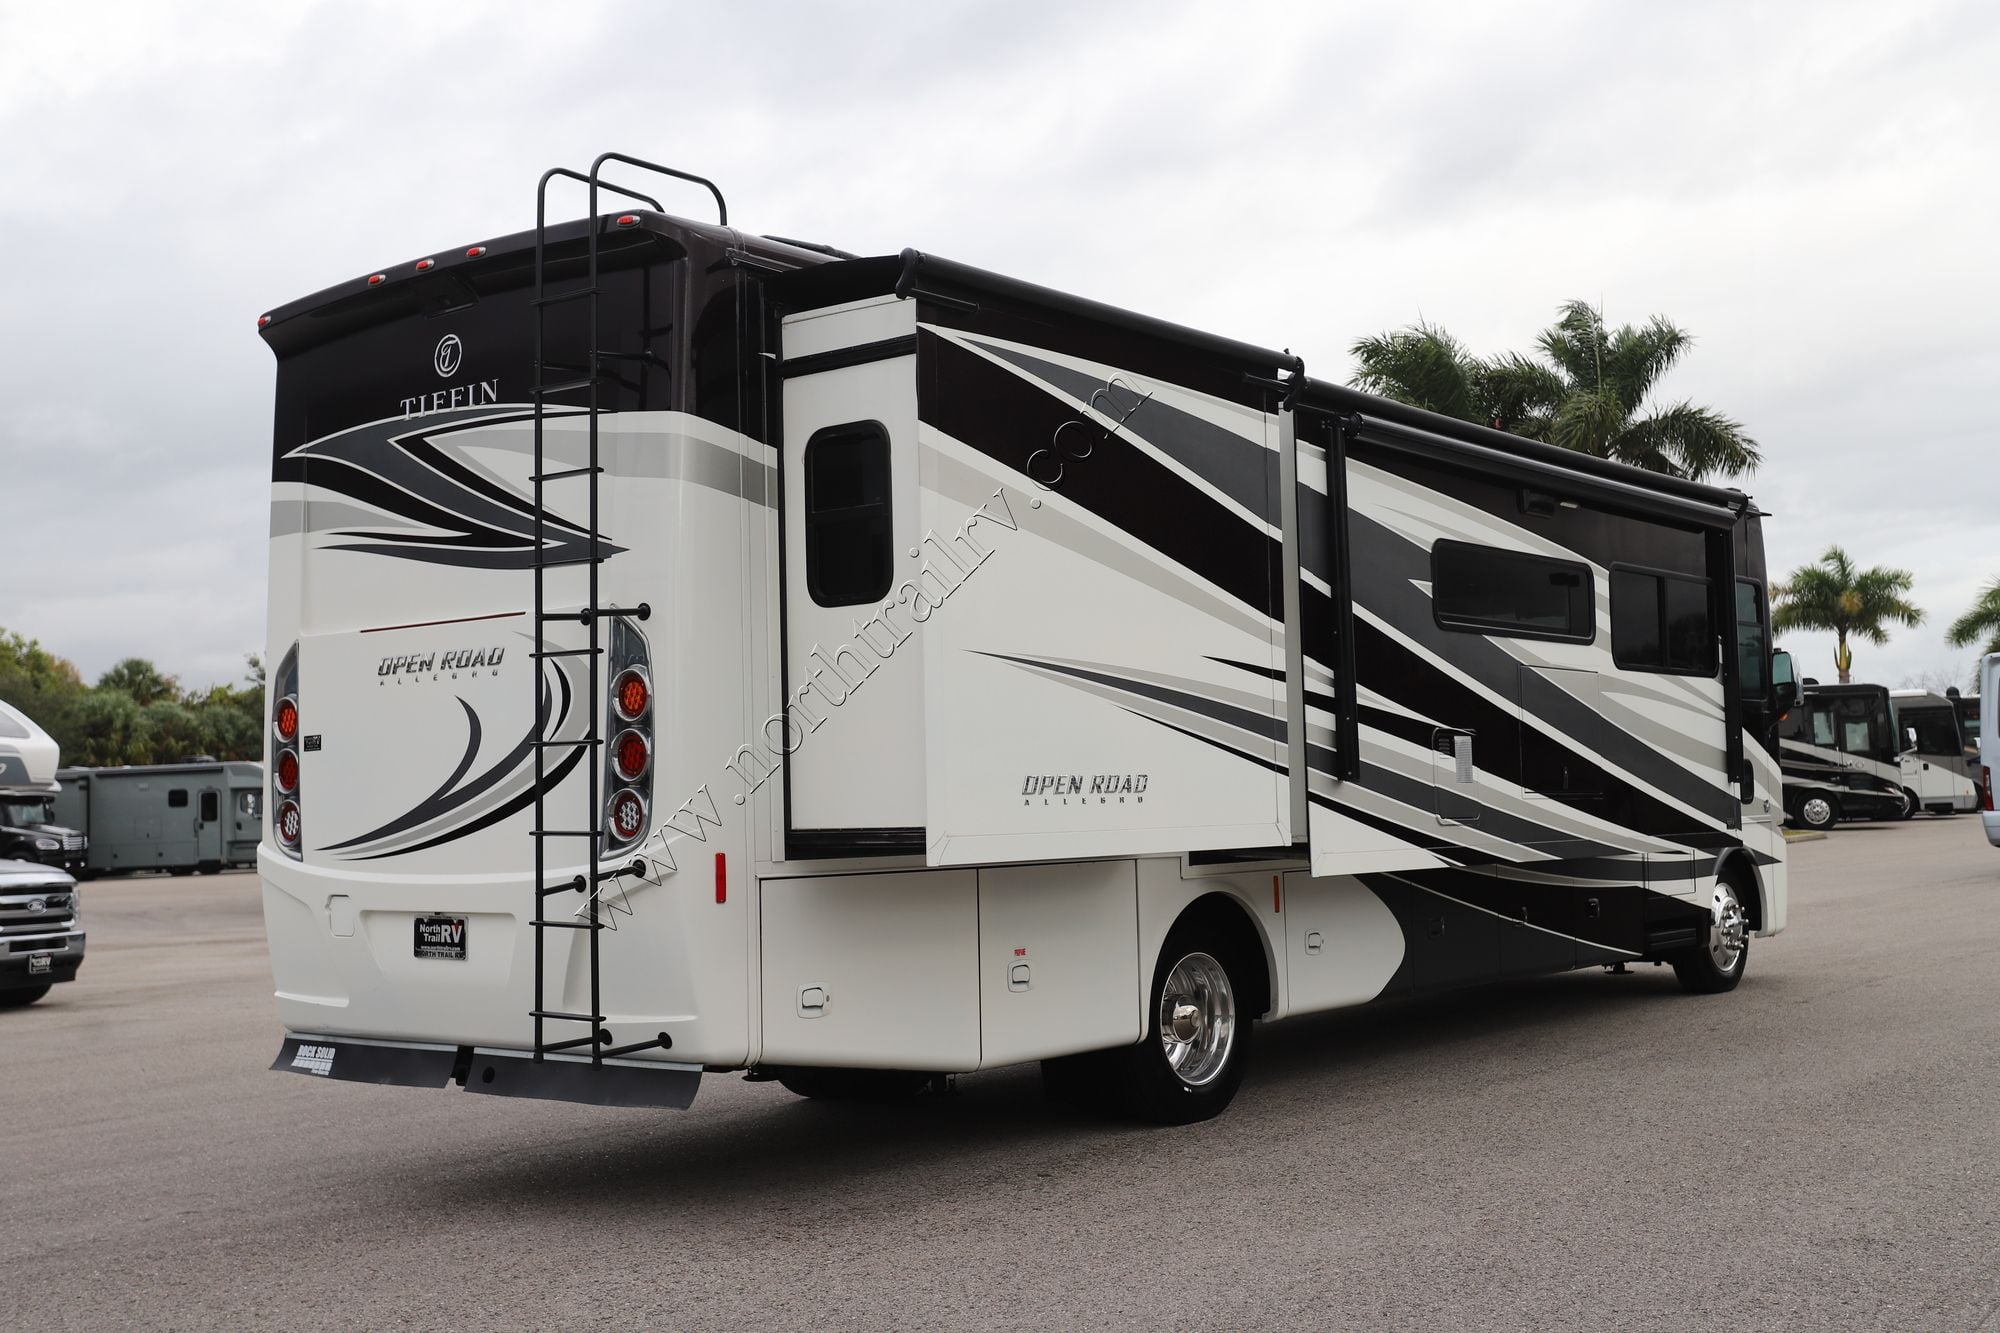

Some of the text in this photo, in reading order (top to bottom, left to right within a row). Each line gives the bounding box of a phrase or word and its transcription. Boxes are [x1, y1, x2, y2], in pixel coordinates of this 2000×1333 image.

[400, 378, 499, 421] TIFFIN
[377, 647, 505, 676] OPEN ROAD
[379, 669, 498, 686] ALLEGRO
[1022, 774, 1149, 796] OPEN ROAD
[1024, 796, 1143, 806] ALLEGRO
[419, 924, 440, 933] North
[441, 925, 462, 943] RV
[423, 933, 440, 942] Trail
[297, 1045, 335, 1059] ROCK SOLID
